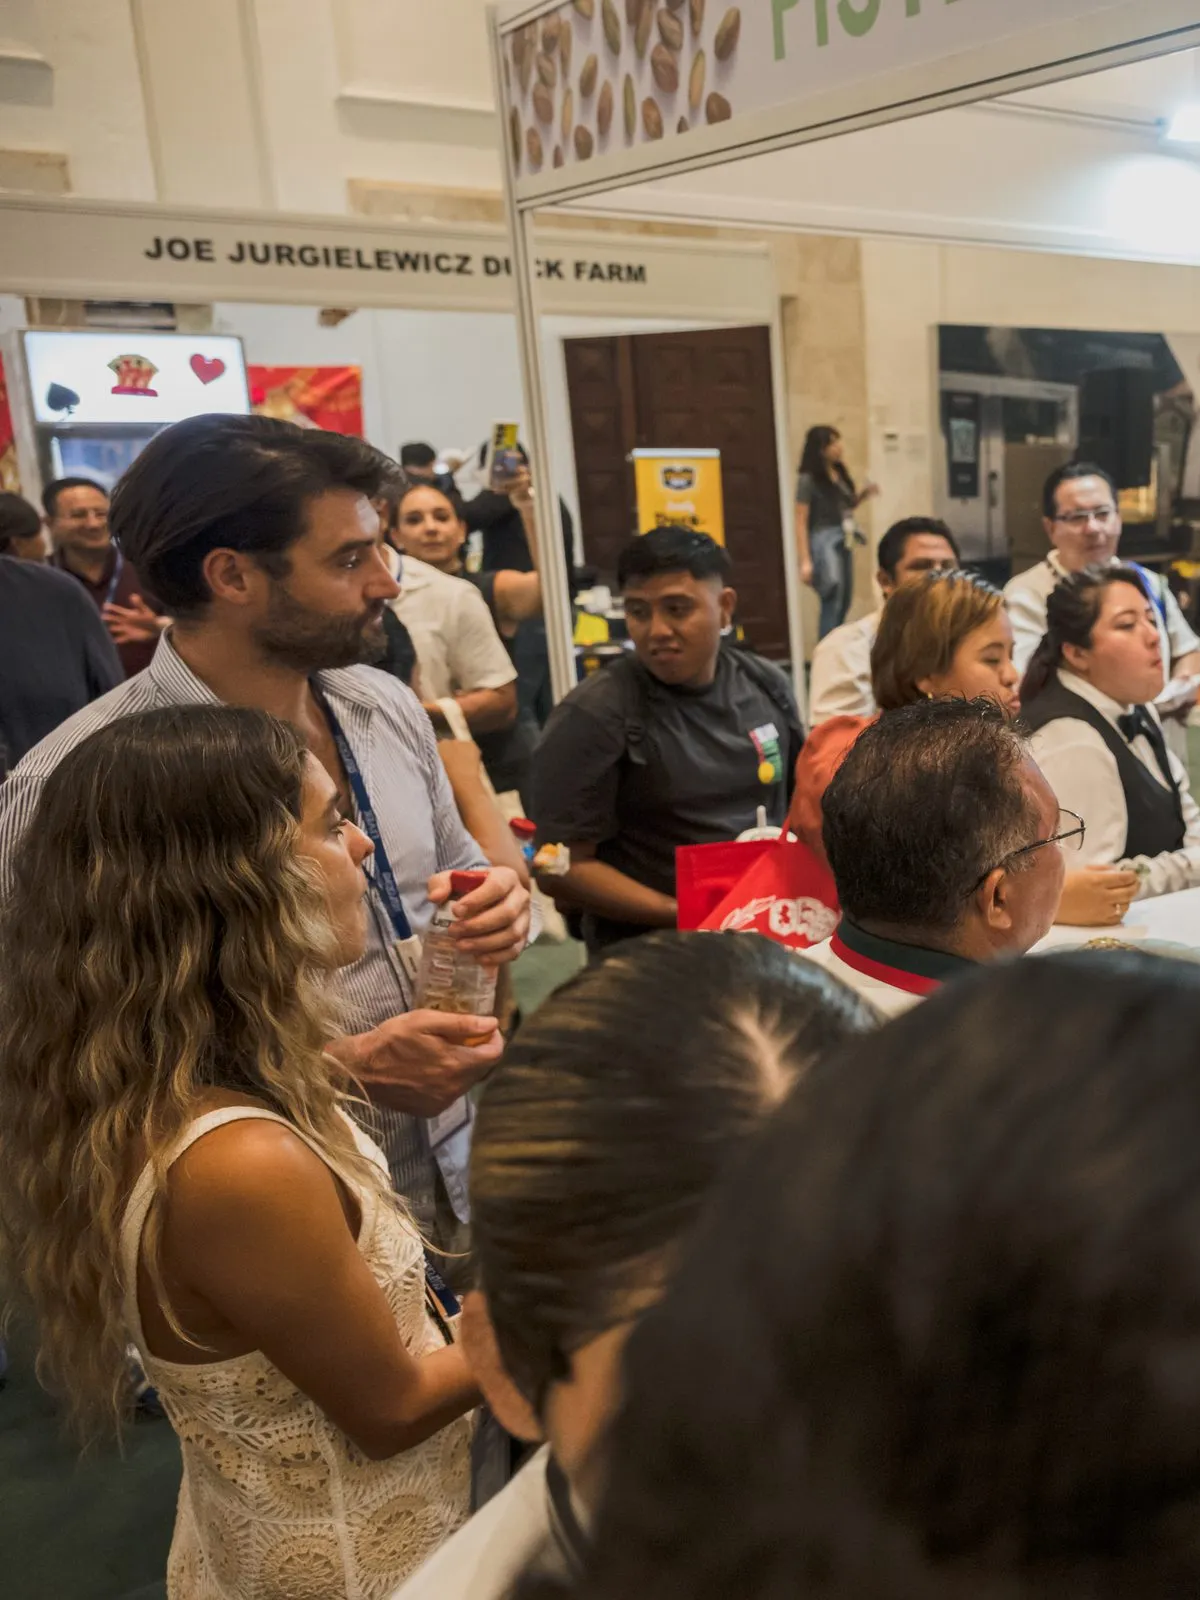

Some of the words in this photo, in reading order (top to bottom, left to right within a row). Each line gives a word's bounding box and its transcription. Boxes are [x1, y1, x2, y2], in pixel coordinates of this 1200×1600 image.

[145, 237, 215, 262] JOE
[228, 241, 474, 275] JURGIELEWICZ
[574, 260, 647, 284] FARM
